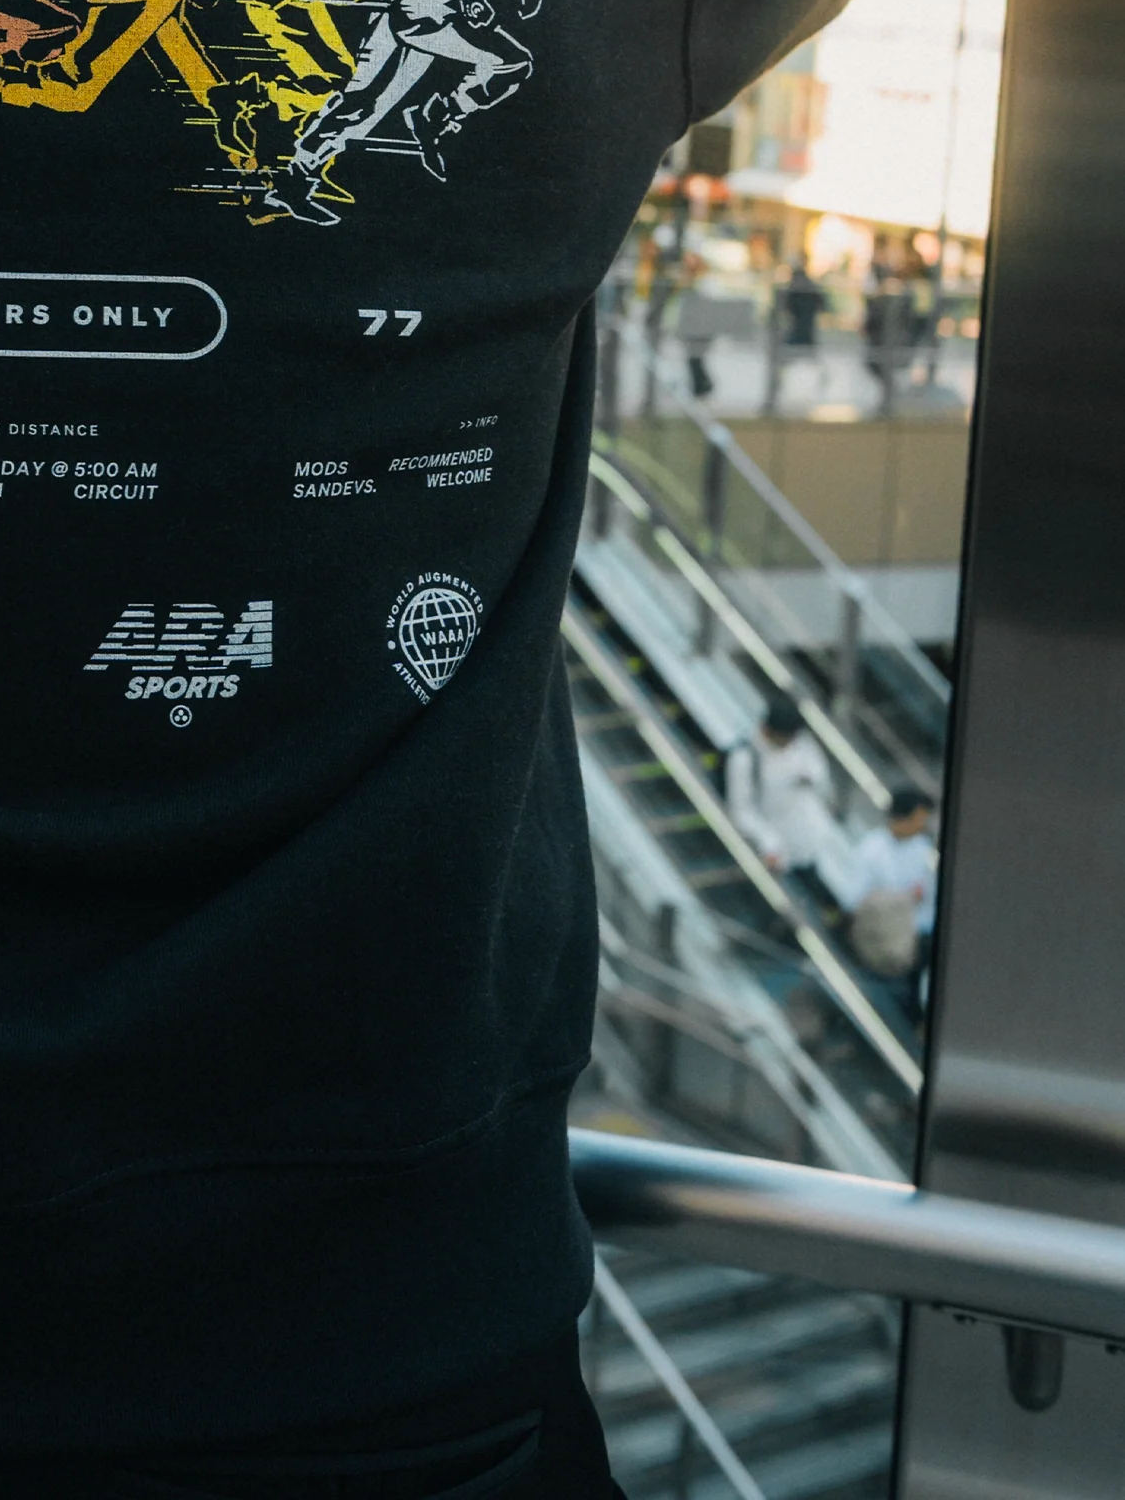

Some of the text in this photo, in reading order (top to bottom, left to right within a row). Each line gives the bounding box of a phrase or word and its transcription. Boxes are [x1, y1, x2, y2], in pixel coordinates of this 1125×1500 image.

[73, 304, 174, 329] ONLY
[357, 308, 423, 338] 77
[8, 423, 100, 437] DISTANCE
[475, 415, 499, 428] INFO
[74, 461, 120, 478] 5:00
[124, 461, 159, 478] AM
[294, 446, 494, 477] MODS RECOMMENDED
[73, 483, 160, 500] CIRCUIT
[292, 467, 493, 499] SANDEVS. WELCOME
[386, 572, 484, 629] WORLD AUGMENTED
[420, 628, 464, 646] WAAA
[124, 674, 241, 700] SPORTS
